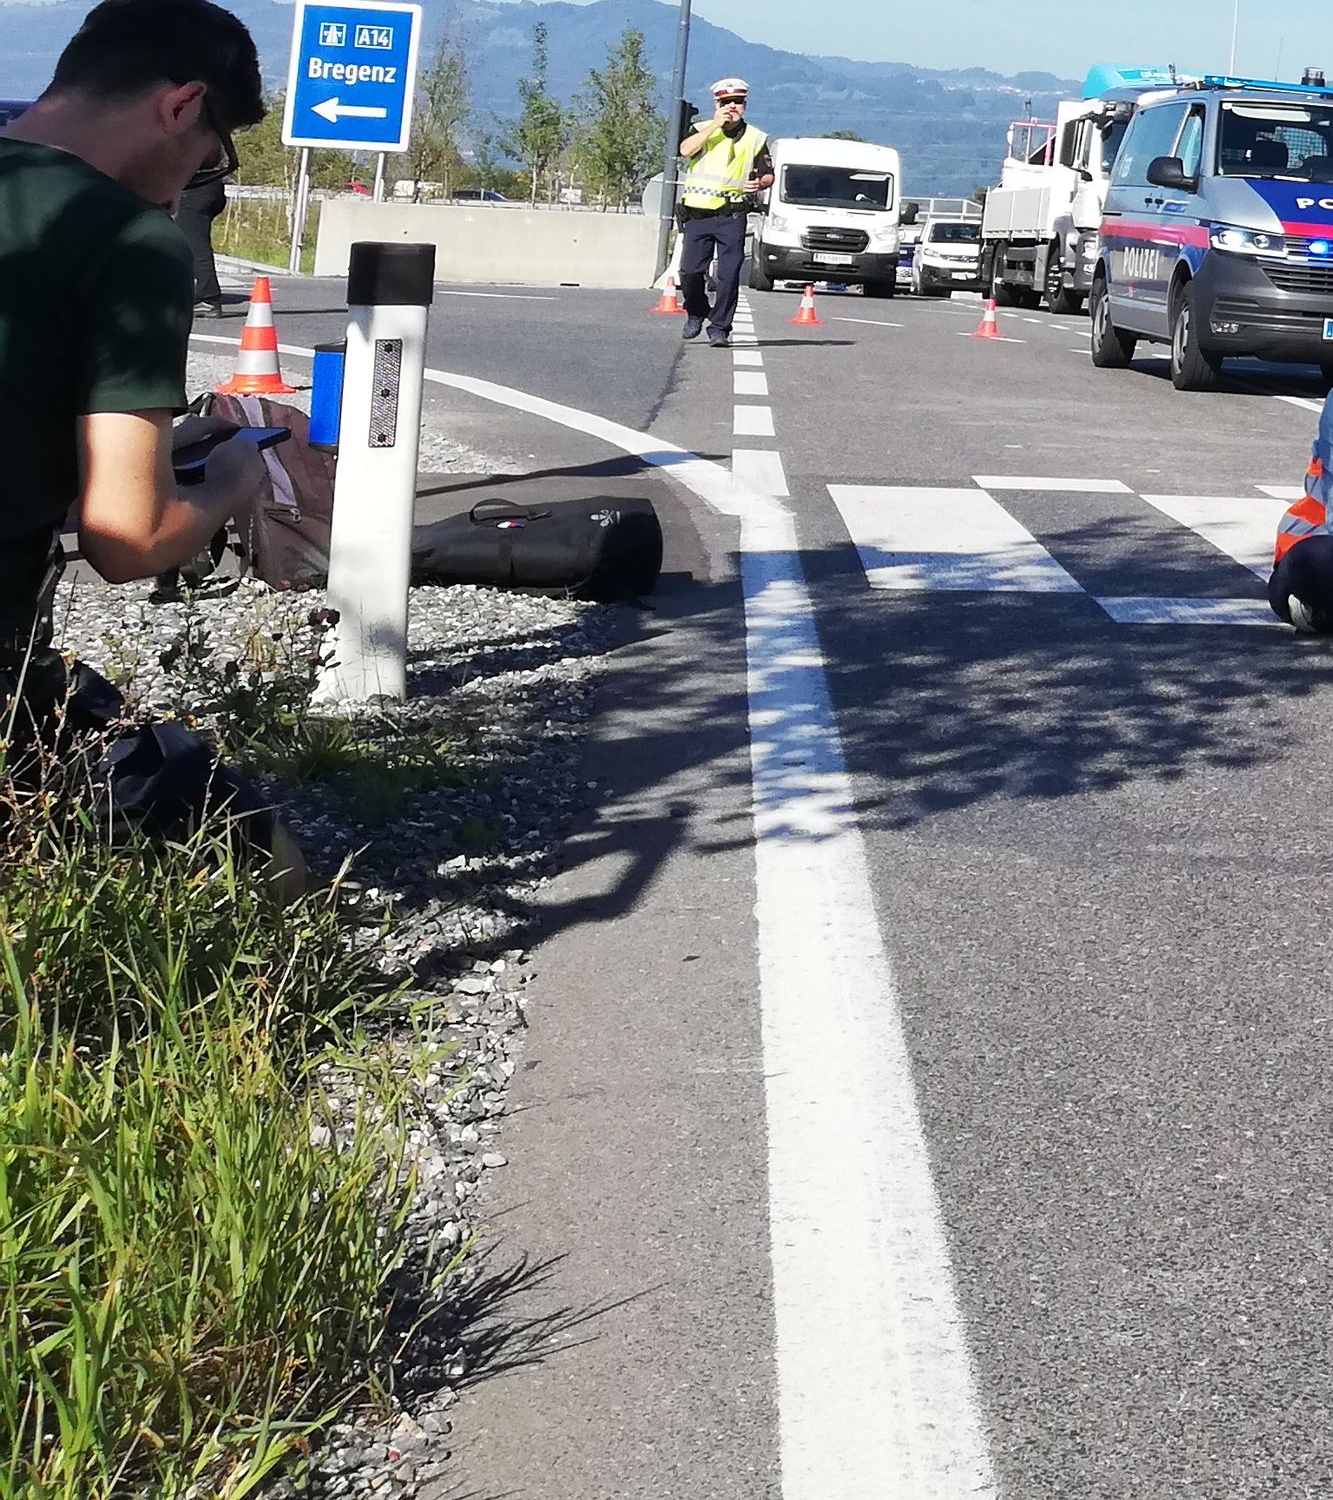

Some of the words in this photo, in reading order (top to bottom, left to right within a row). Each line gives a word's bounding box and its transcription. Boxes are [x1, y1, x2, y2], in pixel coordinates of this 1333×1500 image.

[358, 28, 390, 46] A14
[308, 57, 397, 85] Bregenz
[1123, 246, 1160, 280] POLIZEI
